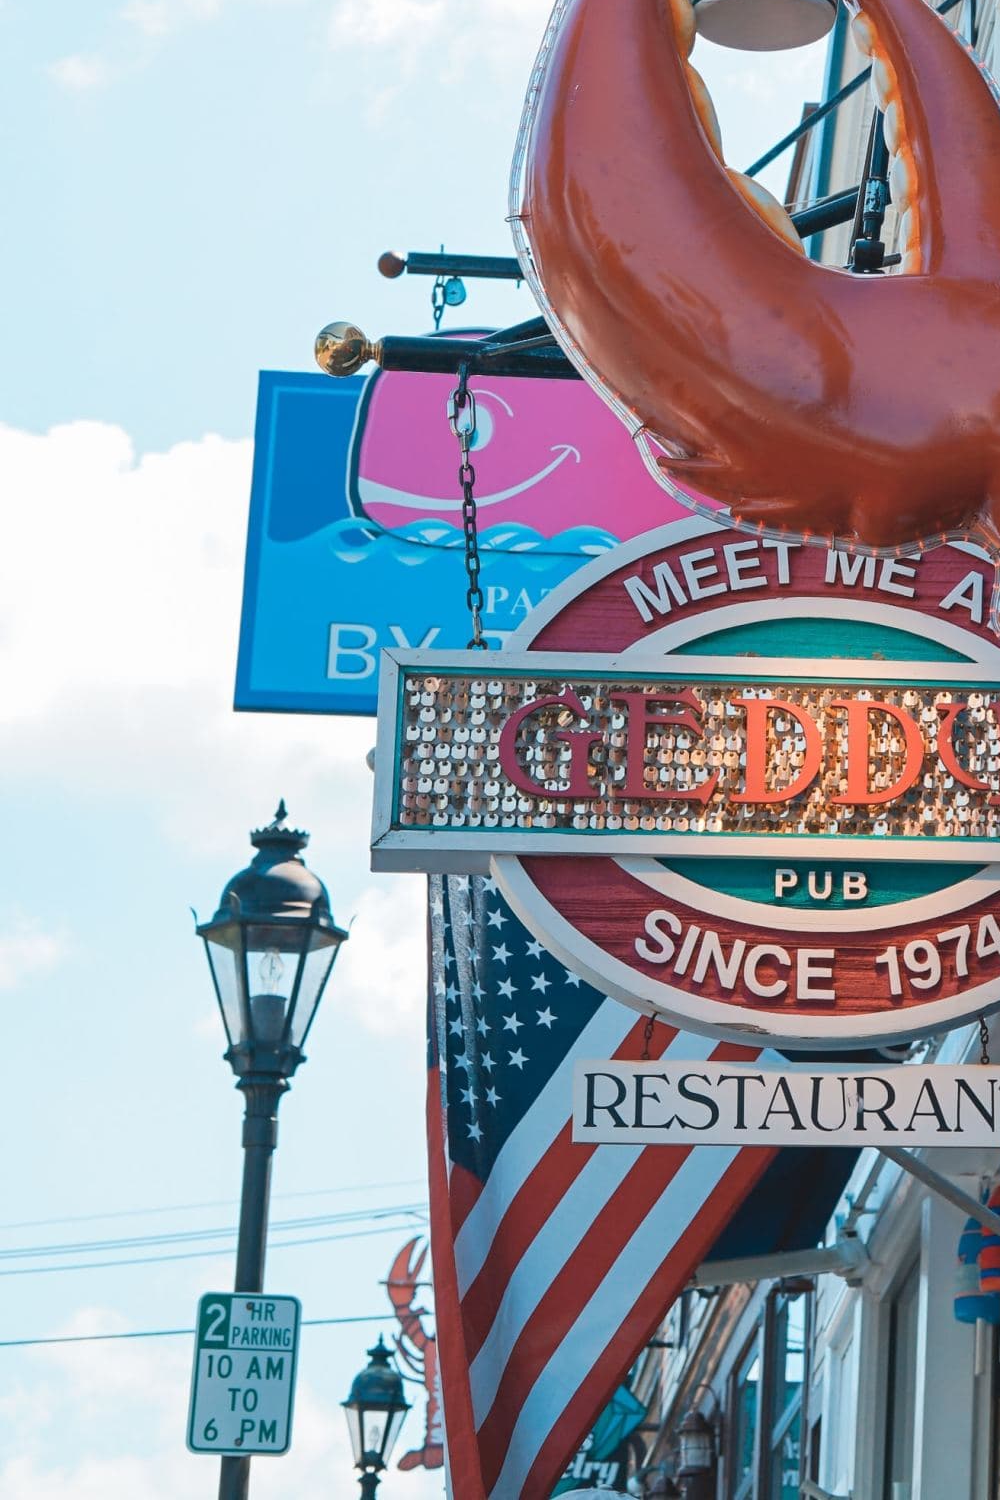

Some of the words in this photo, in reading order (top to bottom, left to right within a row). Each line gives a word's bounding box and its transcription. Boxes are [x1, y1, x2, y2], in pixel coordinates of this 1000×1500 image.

[622, 538, 801, 623] MEET
[823, 546, 922, 598] ME
[938, 570, 997, 629] A
[774, 868, 868, 901] PUB
[634, 909, 837, 1001] SINCE
[203, 1303, 228, 1342] 2
[250, 1302, 276, 1322] HR
[231, 1326, 292, 1347] PARKING
[206, 1354, 233, 1379] 10
[246, 1356, 285, 1381] AM
[228, 1387, 259, 1413] TO
[203, 1417, 219, 1442] 6
[239, 1418, 278, 1444] PM
